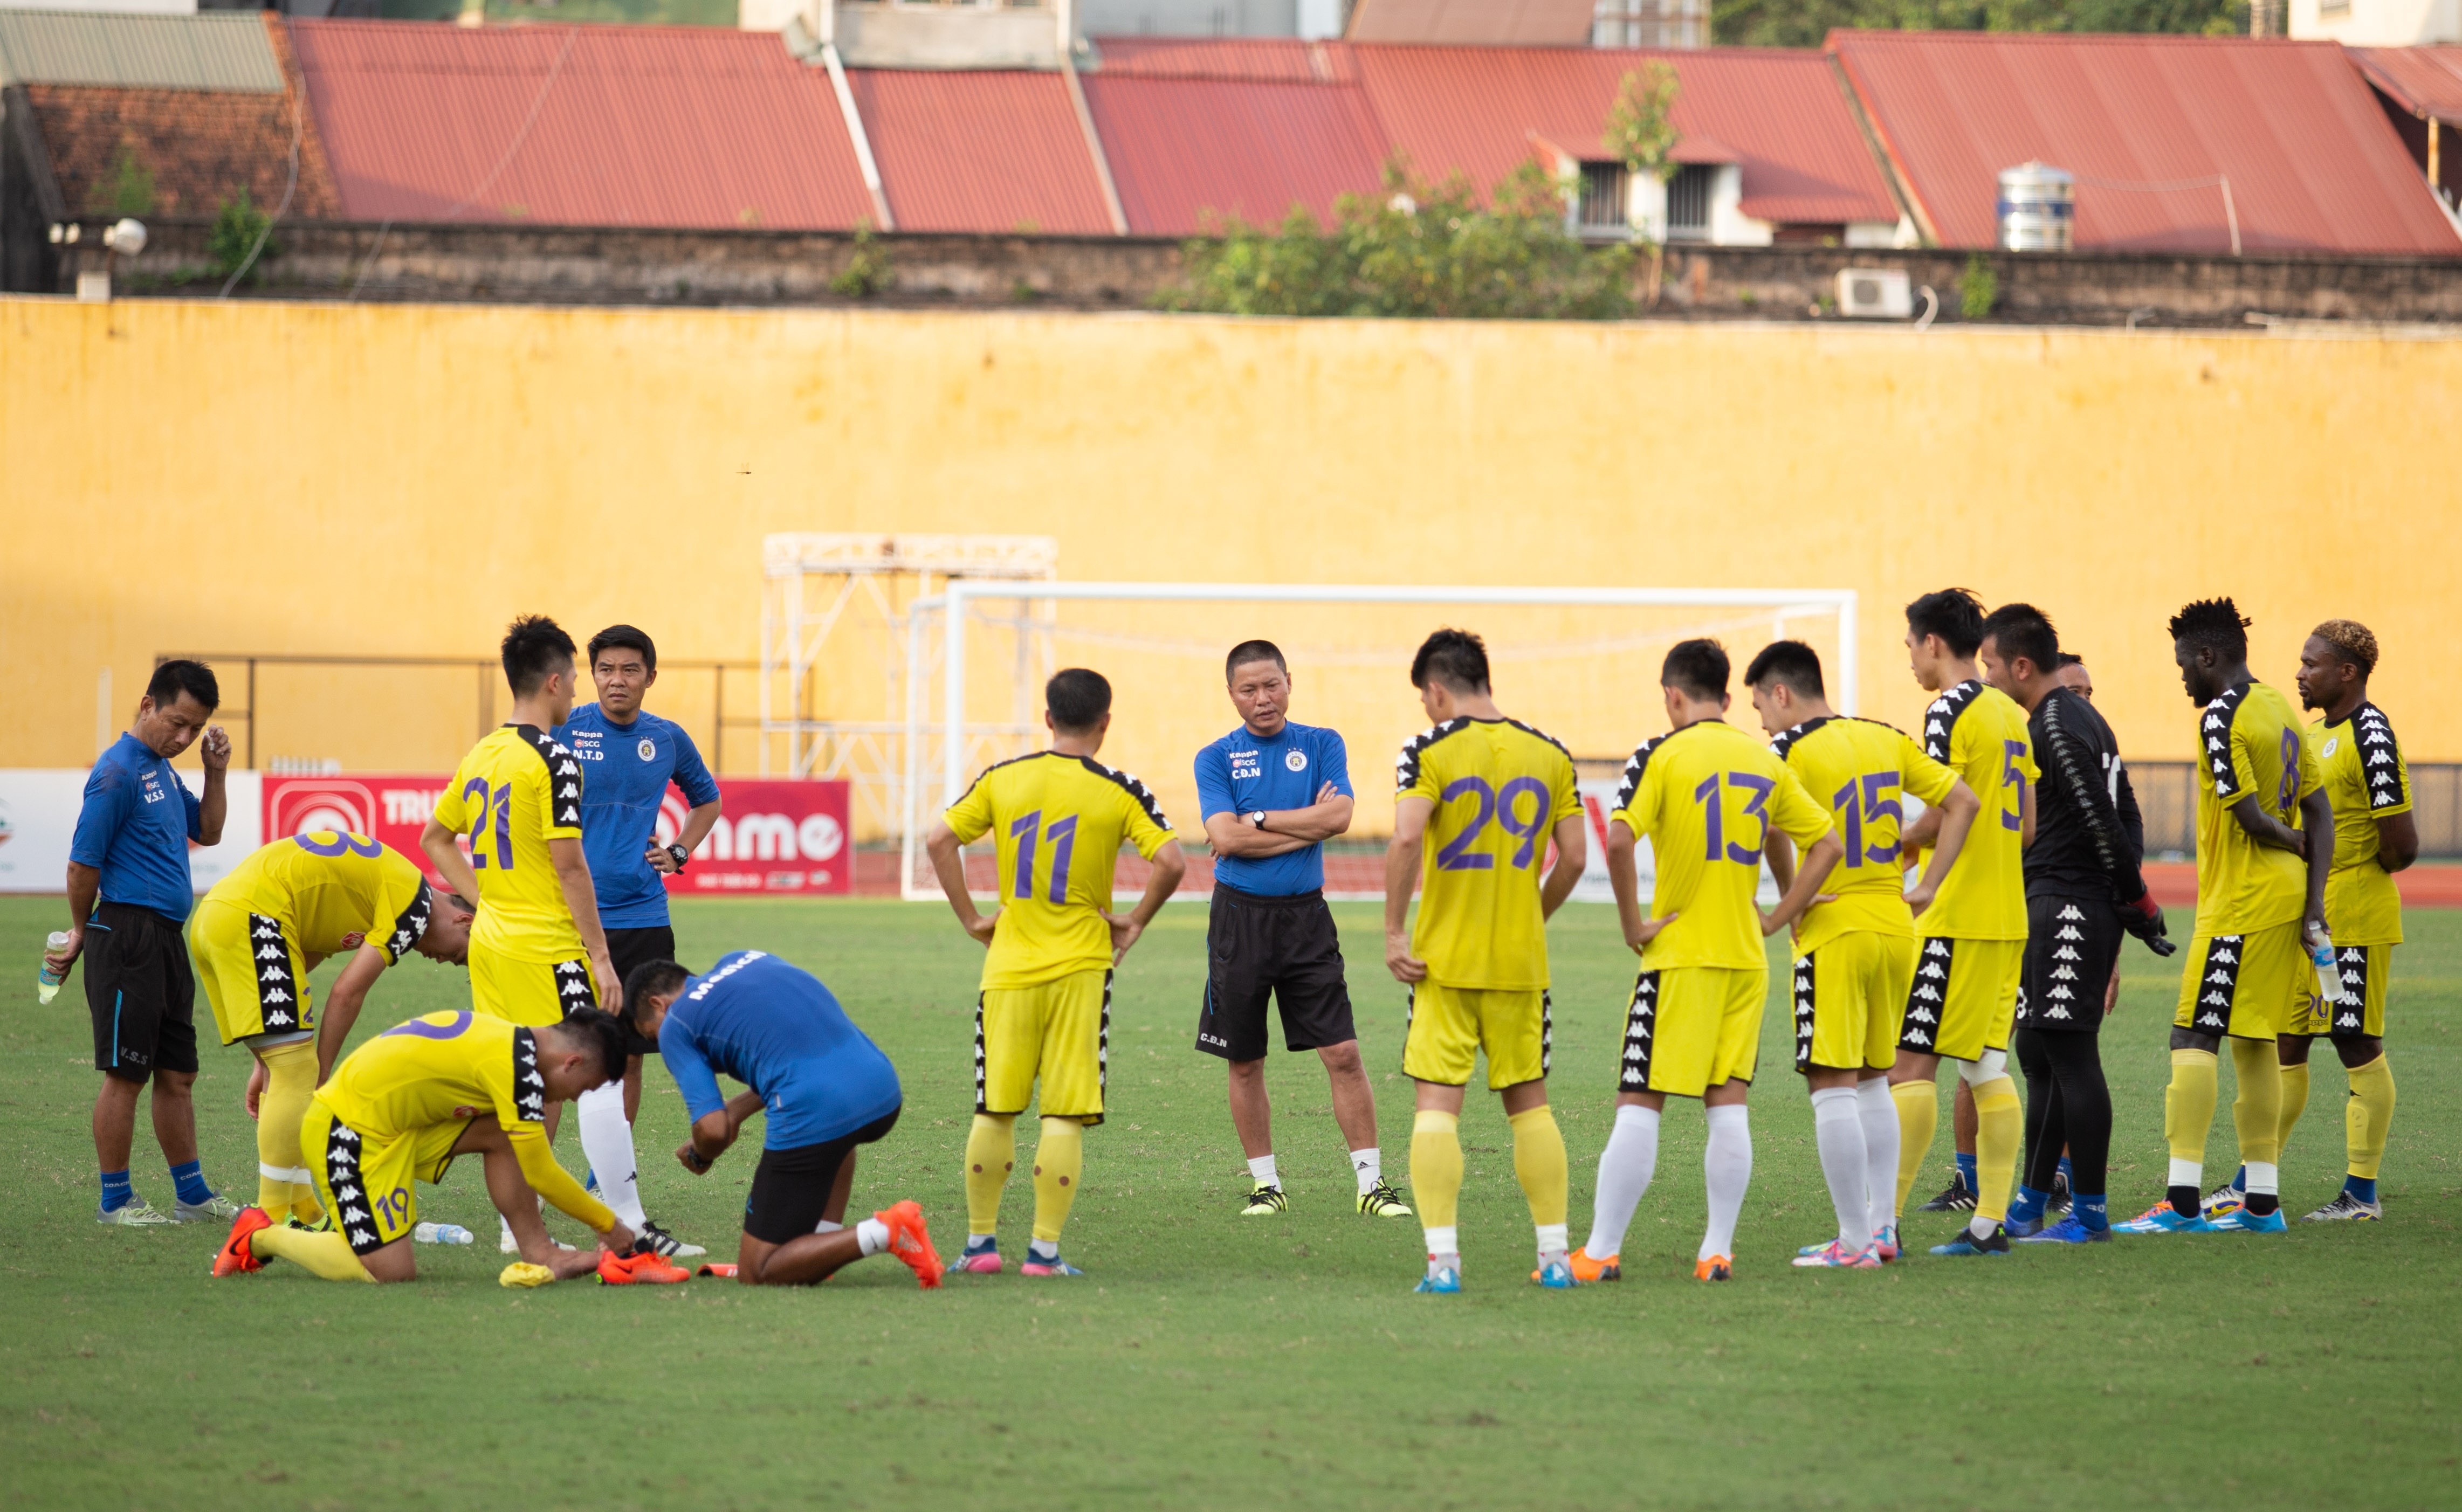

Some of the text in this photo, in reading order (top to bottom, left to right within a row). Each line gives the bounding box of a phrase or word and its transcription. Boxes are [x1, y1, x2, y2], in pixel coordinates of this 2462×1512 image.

[572, 730, 603, 738] Kappa
[573, 749, 604, 761] N.T.D
[1229, 750, 1258, 759] Kappa
[144, 790, 165, 803] V.S.S
[2002, 739, 2027, 831] 5
[2278, 727, 2300, 809] 8
[463, 777, 514, 869] 21
[1437, 776, 1551, 871] 29
[1695, 771, 1777, 866] 13
[1833, 771, 1903, 868] 15
[1010, 810, 1078, 905] 11
[689, 950, 767, 1000] Medical
[120, 1046, 148, 1065] V.S.S
[376, 1187, 409, 1231] 19
